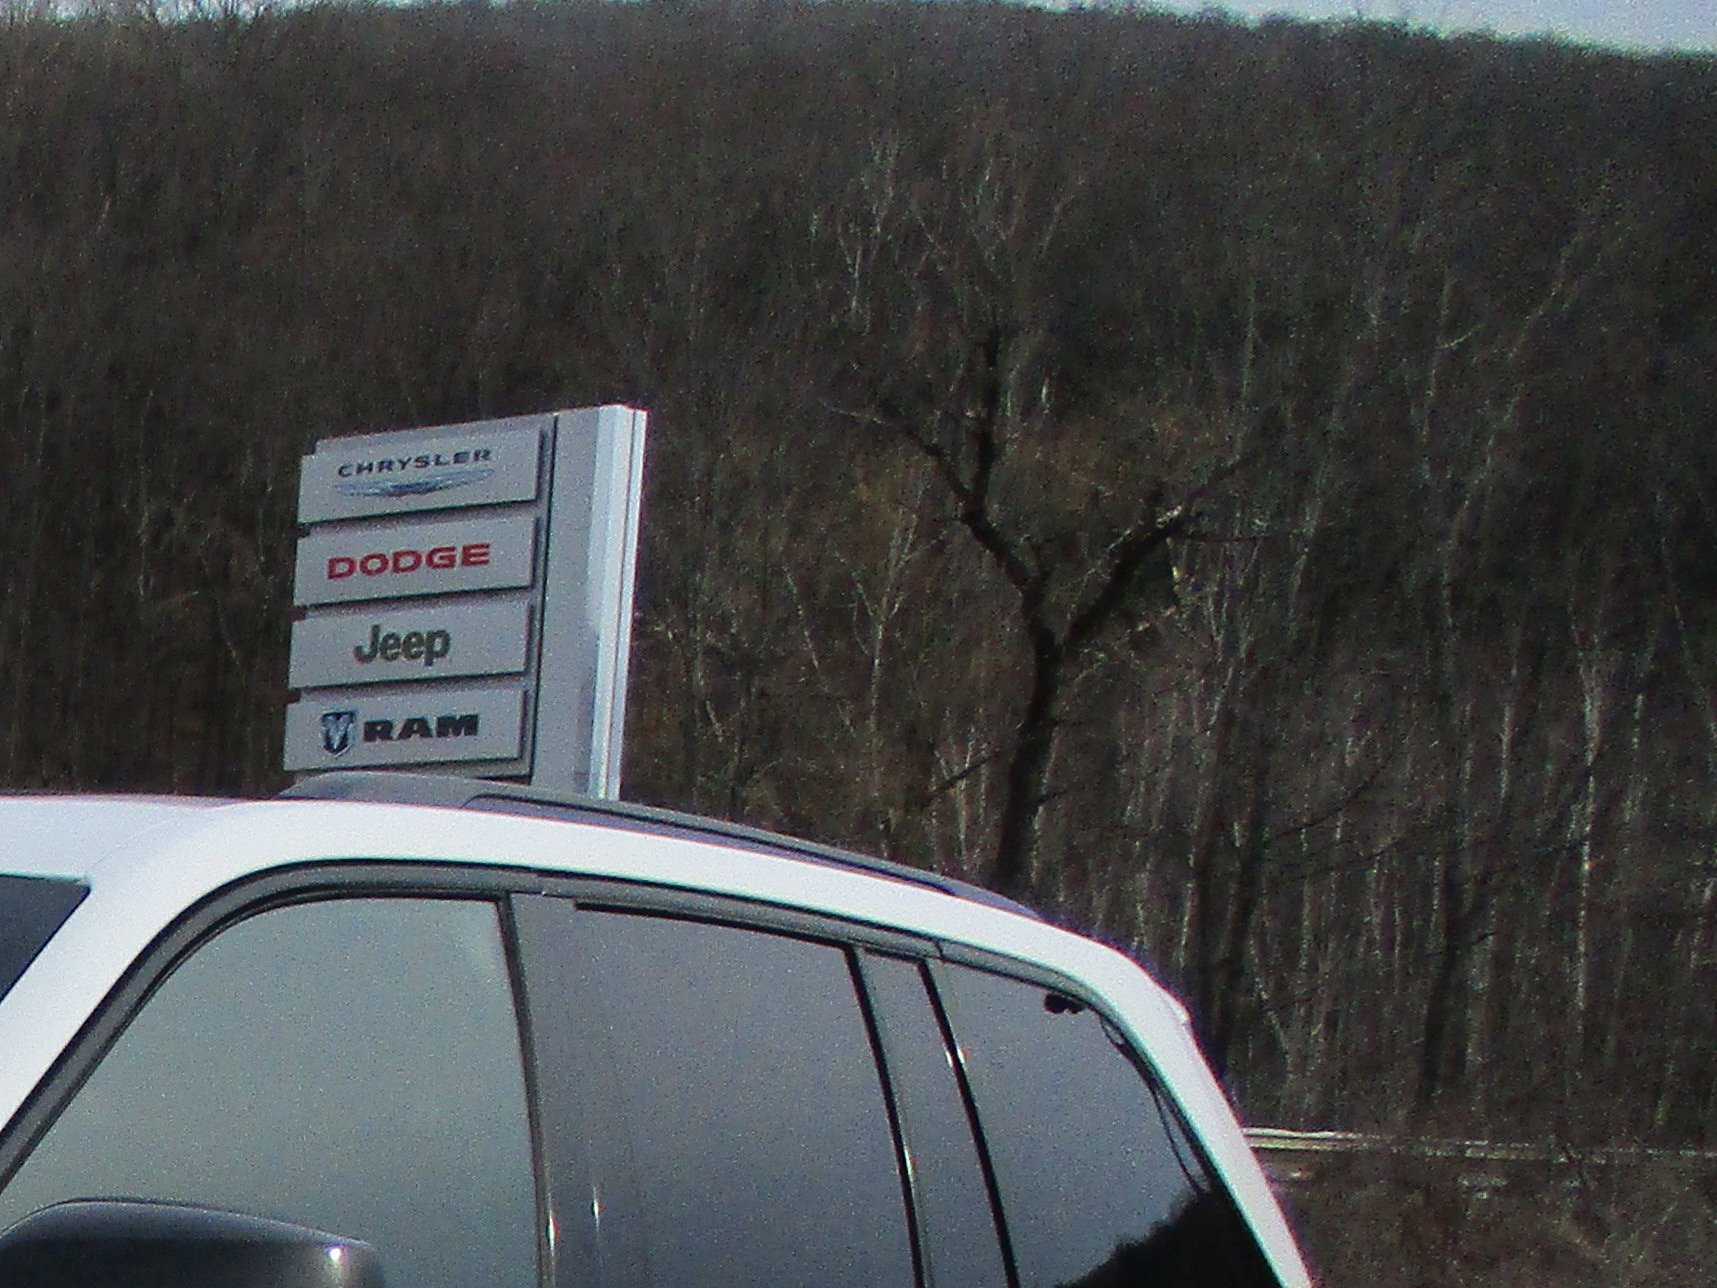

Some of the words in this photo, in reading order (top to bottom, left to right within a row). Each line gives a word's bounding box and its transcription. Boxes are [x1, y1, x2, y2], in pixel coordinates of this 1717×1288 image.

[337, 448, 493, 478] CHRYSLER
[326, 542, 492, 580] DODGE
[353, 623, 452, 667] Jeep
[363, 713, 479, 743] RAM
